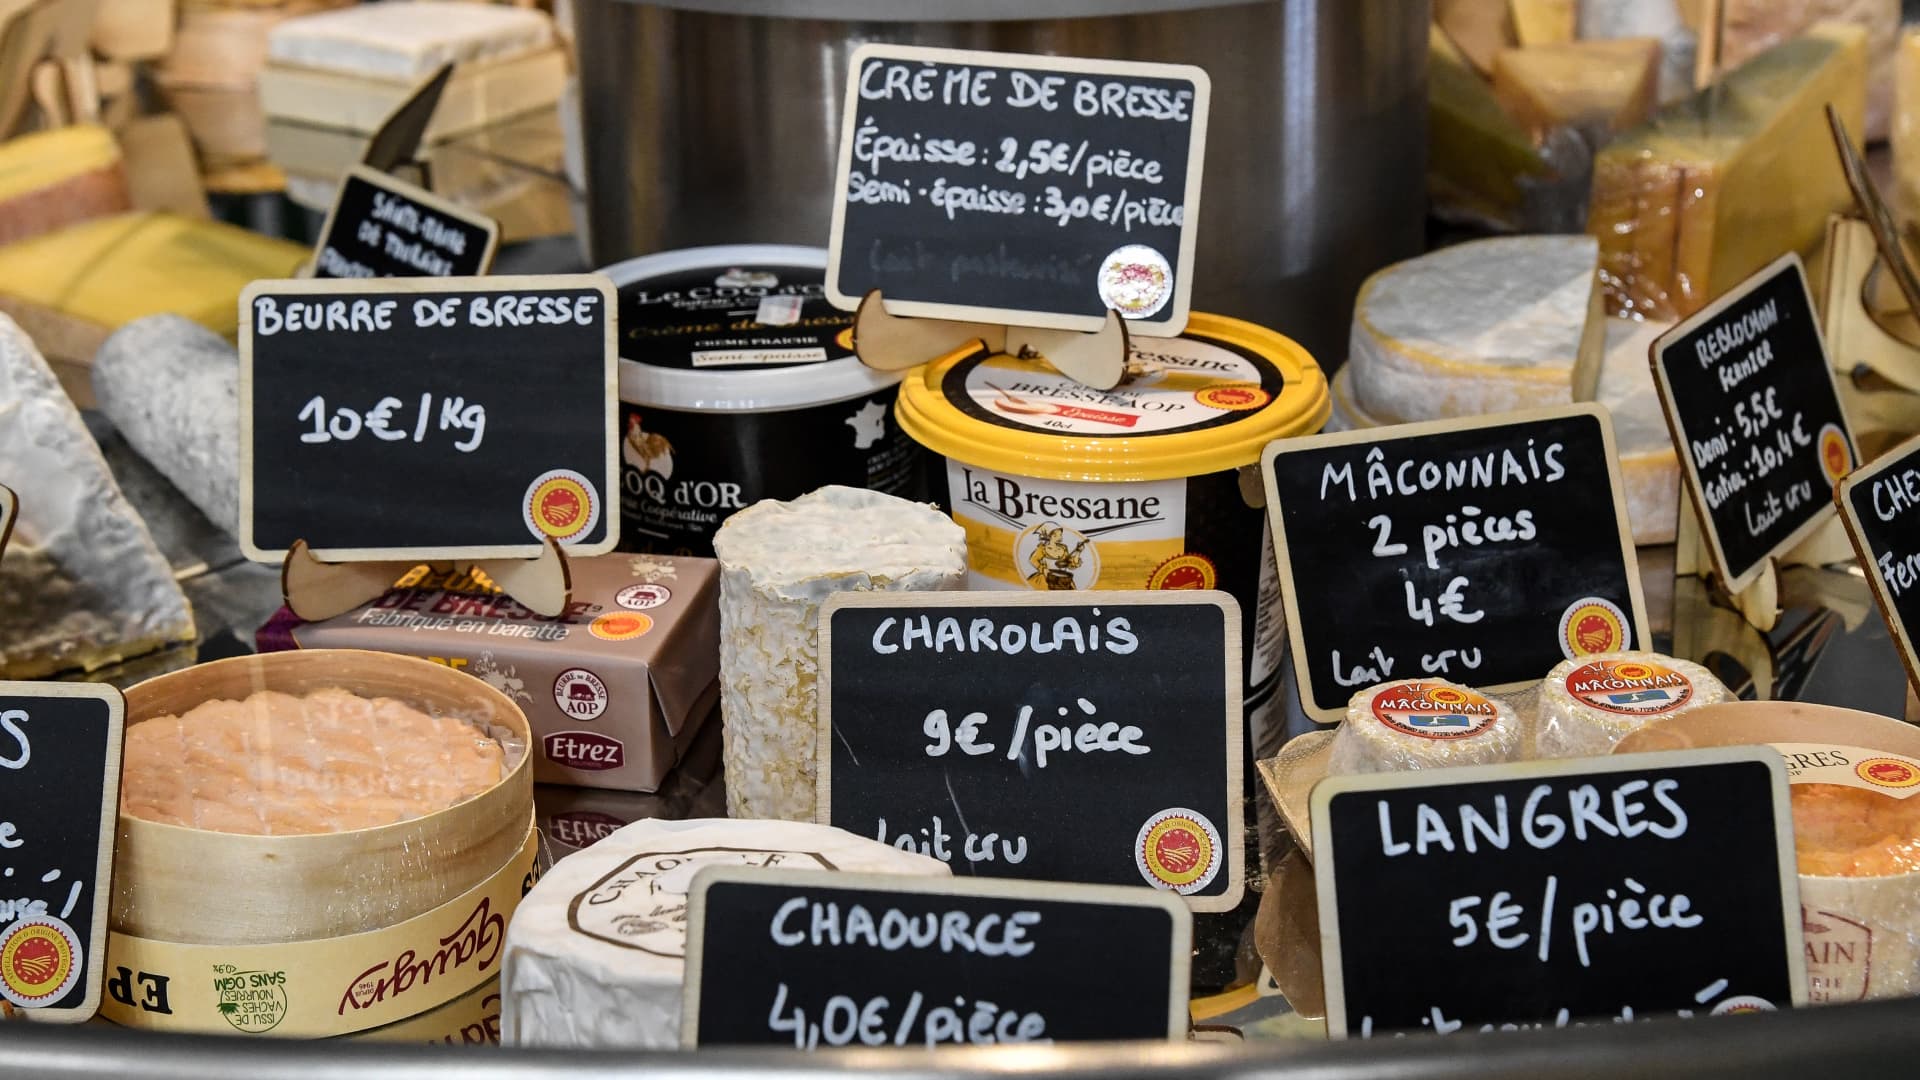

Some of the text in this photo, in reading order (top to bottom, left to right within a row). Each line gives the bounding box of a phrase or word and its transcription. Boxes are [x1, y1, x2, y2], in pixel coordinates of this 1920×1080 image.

[859, 61, 1193, 122] CRÈME DE BRESSE
[689, 286, 768, 299] COQ
[255, 296, 598, 337] BEURRE DE BRESSE
[1695, 299, 1778, 370] REBLOCHON
[623, 470, 666, 504] OQ
[674, 480, 748, 509] d'OR
[994, 476, 1160, 519] Bressane
[1745, 496, 1782, 537] Lait
[1368, 506, 1536, 569] 2 pièces
[1405, 576, 1484, 627] 4€
[357, 606, 571, 641] Fabriqué en baratte
[1332, 647, 1482, 687] Lait cru
[1575, 672, 1682, 692] MÂCONNAIS
[566, 701, 599, 714] AOP
[1380, 697, 1491, 714] MÂCONNAIS
[552, 738, 618, 763] Etrez
[1378, 779, 1689, 856] LANGRES
[964, 831, 1027, 864] cru
[769, 897, 1042, 957] CHAOURCE
[338, 897, 504, 1015] Gaugry
[214, 971, 286, 990] SANS OGM
[224, 989, 273, 1001] NOURRIES
[235, 1014, 275, 1025] ISSU DE
[242, 1001, 283, 1012] VACHES
